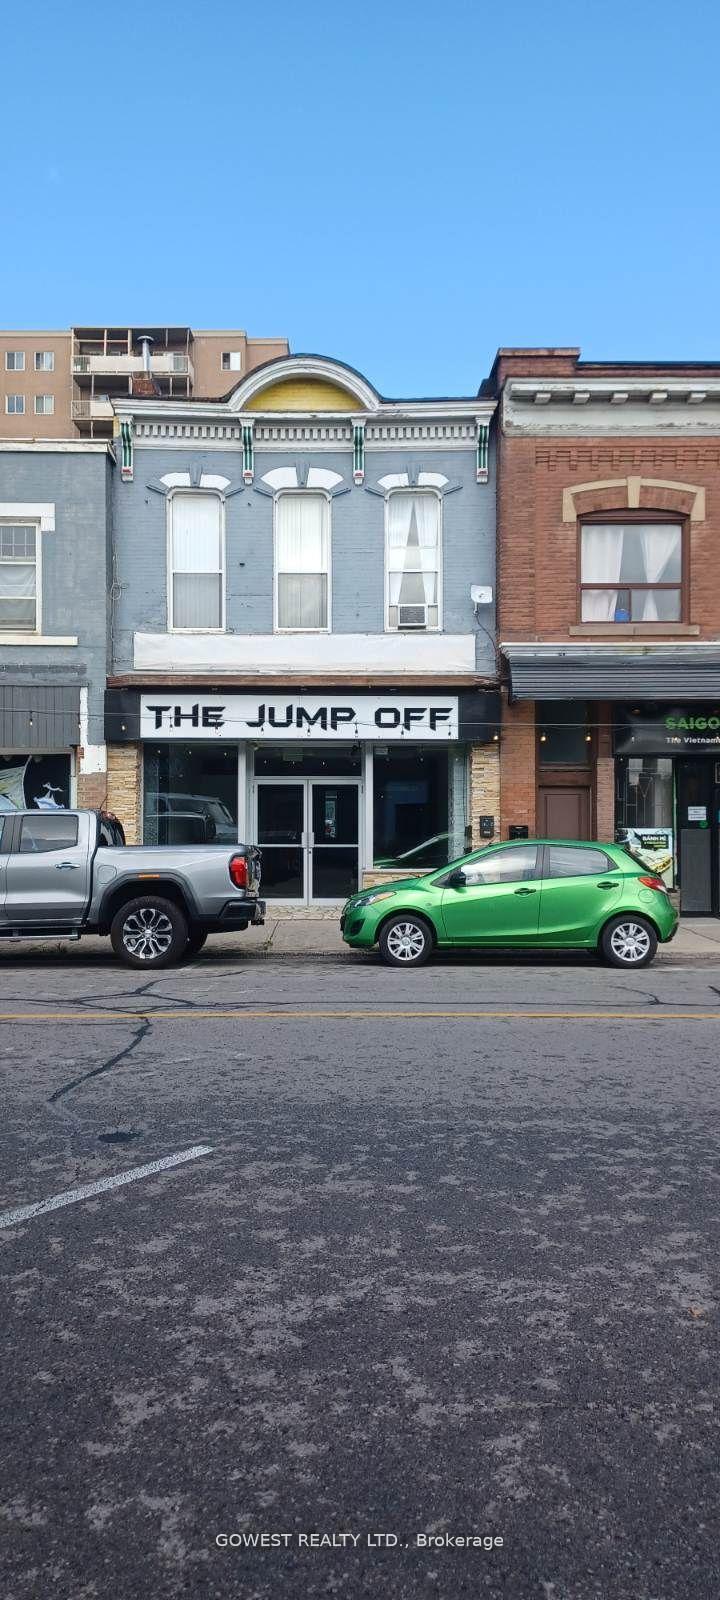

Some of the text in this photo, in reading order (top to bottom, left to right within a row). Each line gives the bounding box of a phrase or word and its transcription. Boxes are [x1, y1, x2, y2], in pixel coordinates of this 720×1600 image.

[146, 704, 454, 731] THE JUMP OFF
